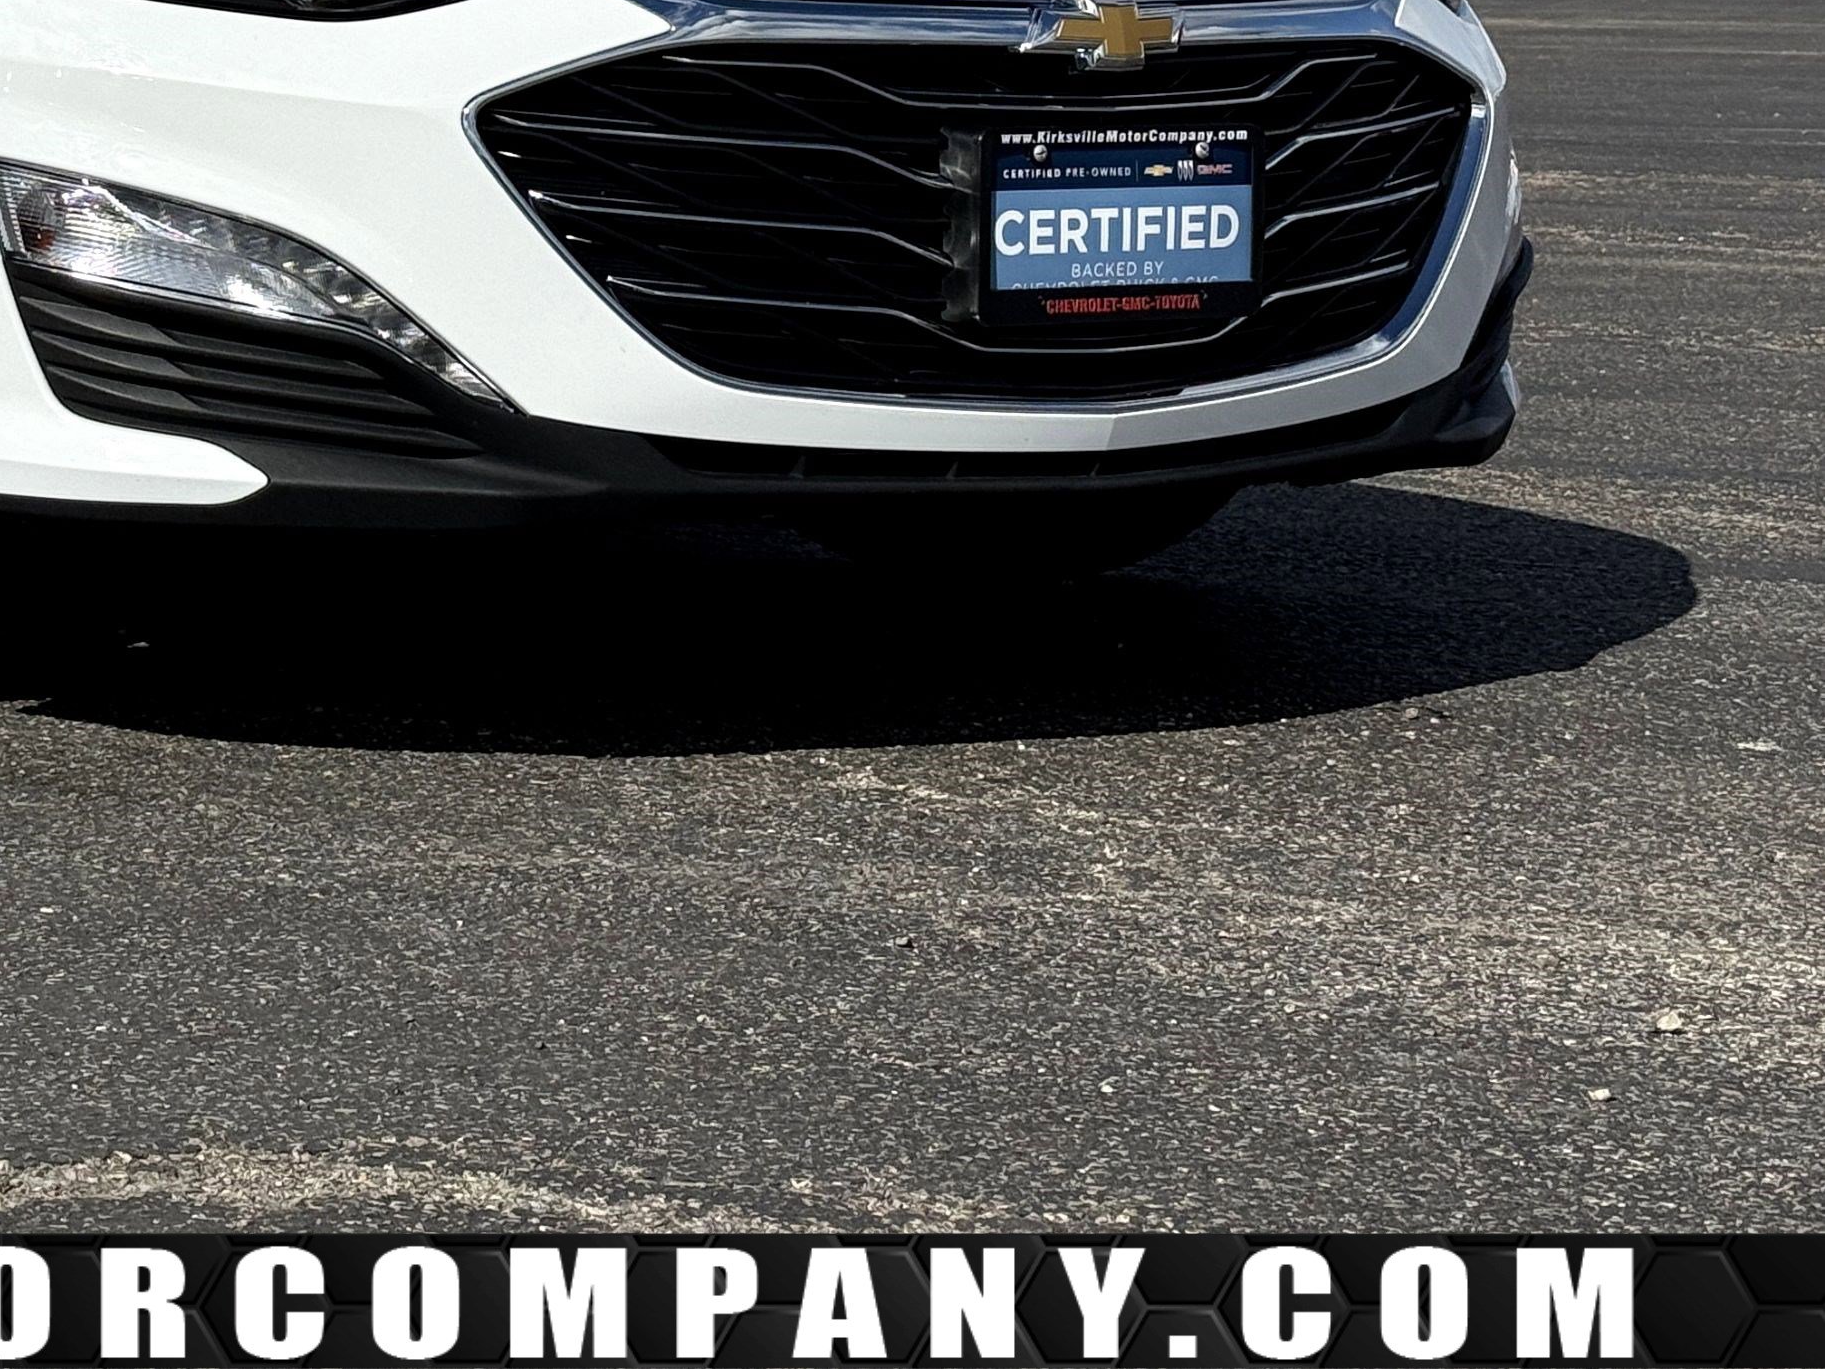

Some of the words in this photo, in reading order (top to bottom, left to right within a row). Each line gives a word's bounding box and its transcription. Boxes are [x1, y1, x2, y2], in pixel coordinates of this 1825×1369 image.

[1000, 129, 1248, 144] www.KirksvilleMotorCompany.com
[1002, 168, 1062, 179] CERTIFIED
[1065, 166, 1132, 178] PRE-OWNED
[1196, 163, 1233, 176] GMC
[994, 204, 1241, 256] CERTIFIED
[1070, 261, 1138, 278] BACKED
[1143, 260, 1165, 276] BY
